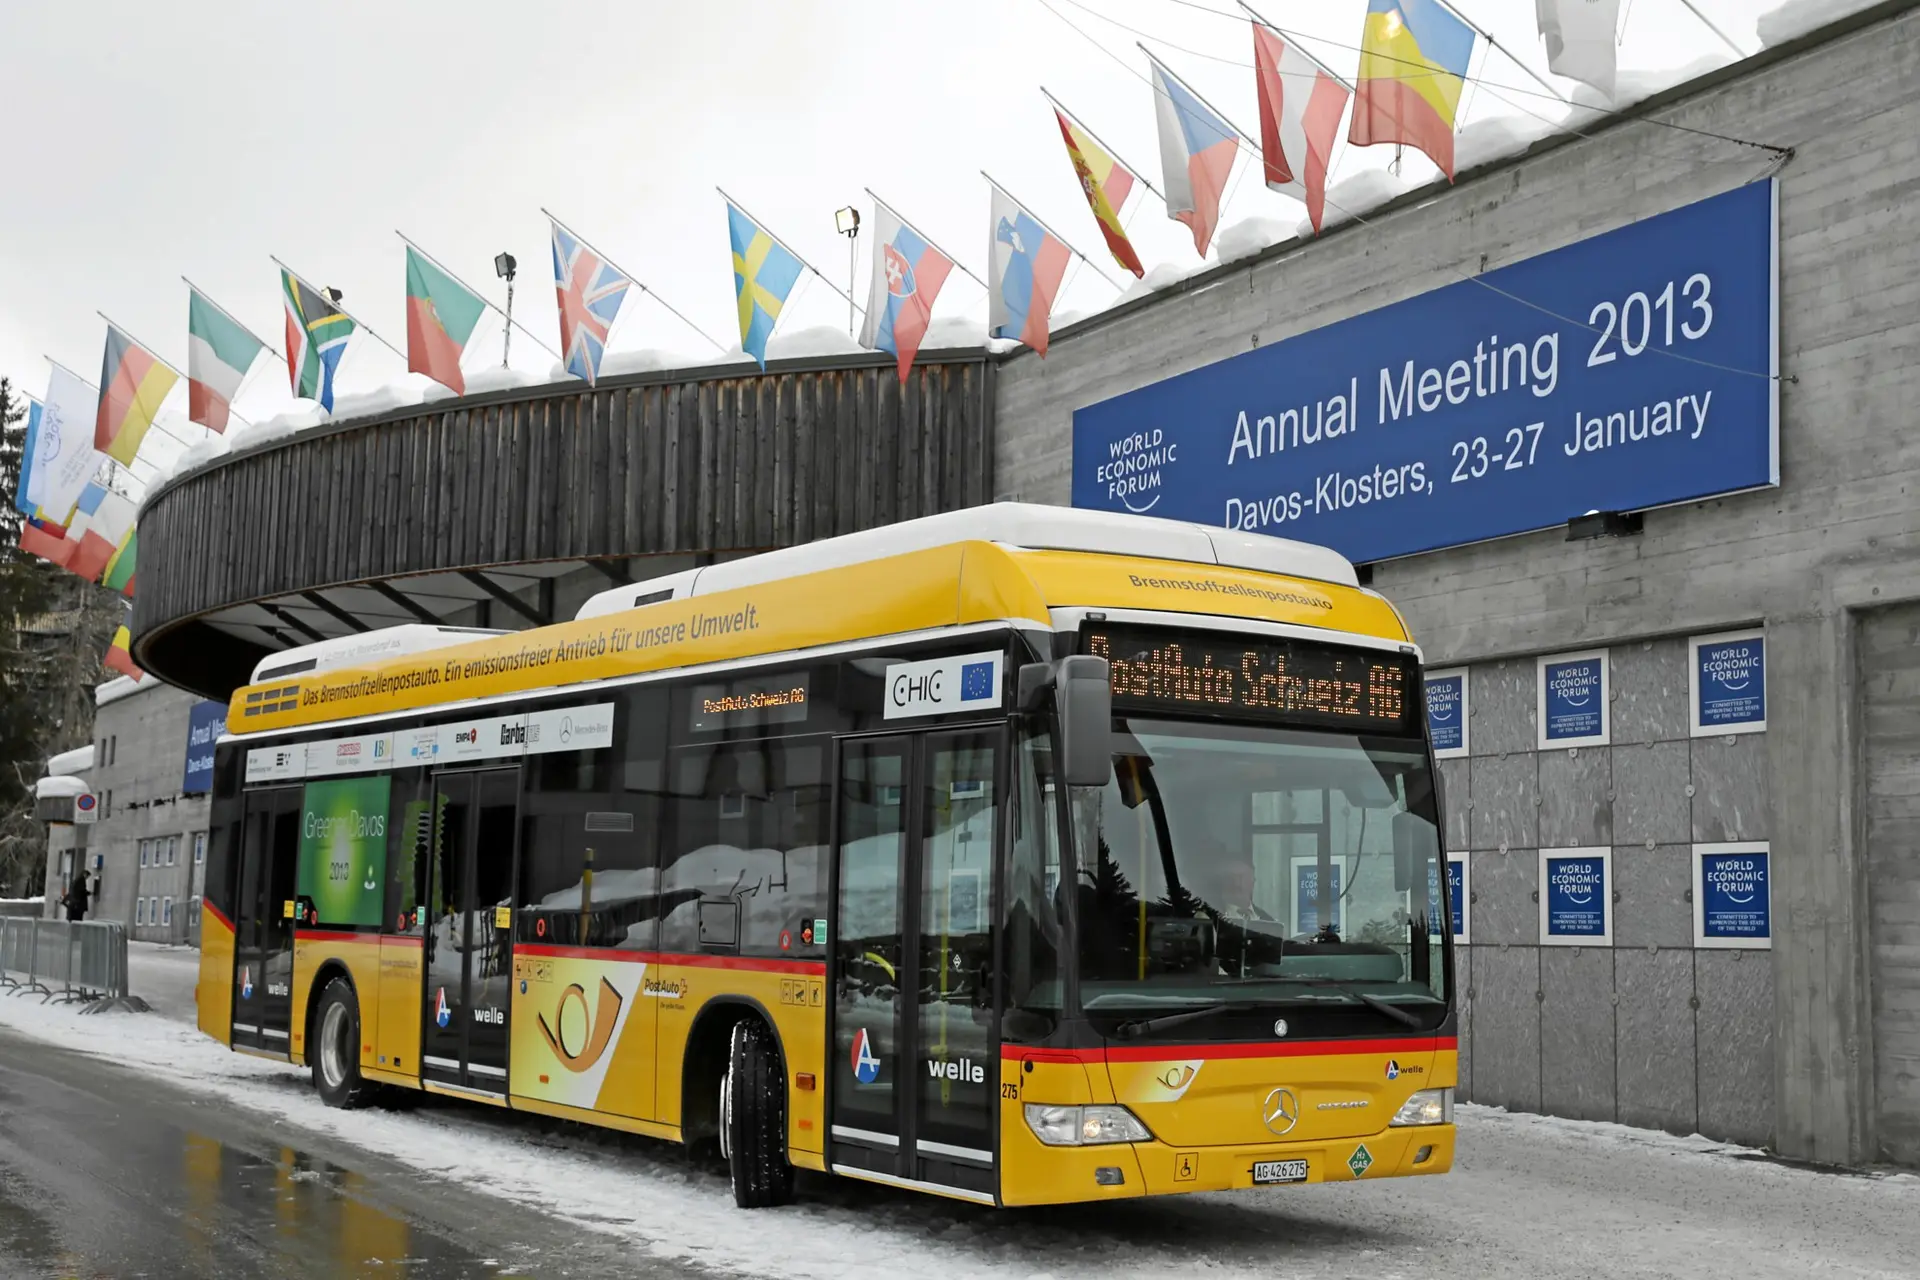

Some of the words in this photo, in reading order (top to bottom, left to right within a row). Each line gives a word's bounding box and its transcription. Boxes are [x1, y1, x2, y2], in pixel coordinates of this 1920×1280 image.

[1228, 377, 1357, 465] Annual
[1379, 332, 1558, 424] Meeting
[1587, 273, 1713, 367] 2013
[1110, 429, 1162, 458] WORLD
[1098, 444, 1176, 482] ECONOMIC
[1226, 462, 1433, 531] Davos-Klosters,
[1451, 422, 1544, 483] 23-27
[1565, 391, 1711, 456] January
[1109, 470, 1160, 499] FORUM
[1129, 575, 1332, 610] Brennstoffzellenpostauto
[303, 688, 319, 706] Das
[445, 660, 462, 681] Ein
[464, 644, 553, 678] emissionsfreier
[555, 633, 605, 662] Antrieb
[610, 628, 632, 653] für
[636, 622, 685, 649] unsere
[691, 603, 759, 639] Umwelt.
[1712, 648, 1749, 660] WORLD
[1703, 657, 1759, 672] ECONOMIC
[1557, 667, 1589, 678] WORLD
[1712, 670, 1749, 681] FORUM
[893, 670, 943, 706] CHIC
[1241, 652, 1361, 715] Schweiz
[1369, 665, 1402, 719] AG
[1550, 675, 1598, 689] ECONOMIC
[1427, 692, 1459, 703] ONOMIC
[1557, 687, 1589, 698] FORUM
[703, 695, 749, 713] PostAuto
[749, 690, 789, 708] Schweiz
[790, 687, 804, 703] AG
[1428, 703, 1452, 712] ORUM
[350, 810, 385, 838] Davos
[1559, 864, 1592, 874] WORLD
[1716, 860, 1754, 871] WORLD
[1552, 874, 1601, 884] ECONOMIC
[1707, 871, 1764, 882] ECONOMIC
[1560, 884, 1592, 894] FORUM
[1716, 883, 1754, 892] FORUM
[268, 982, 288, 996] welle
[644, 978, 680, 993] PostAuto
[474, 1007, 504, 1024] welle
[928, 1058, 984, 1083] welle
[1400, 1065, 1423, 1074] welle
[1002, 1083, 1017, 1100] 275
[1352, 1160, 1369, 1170] GAS
